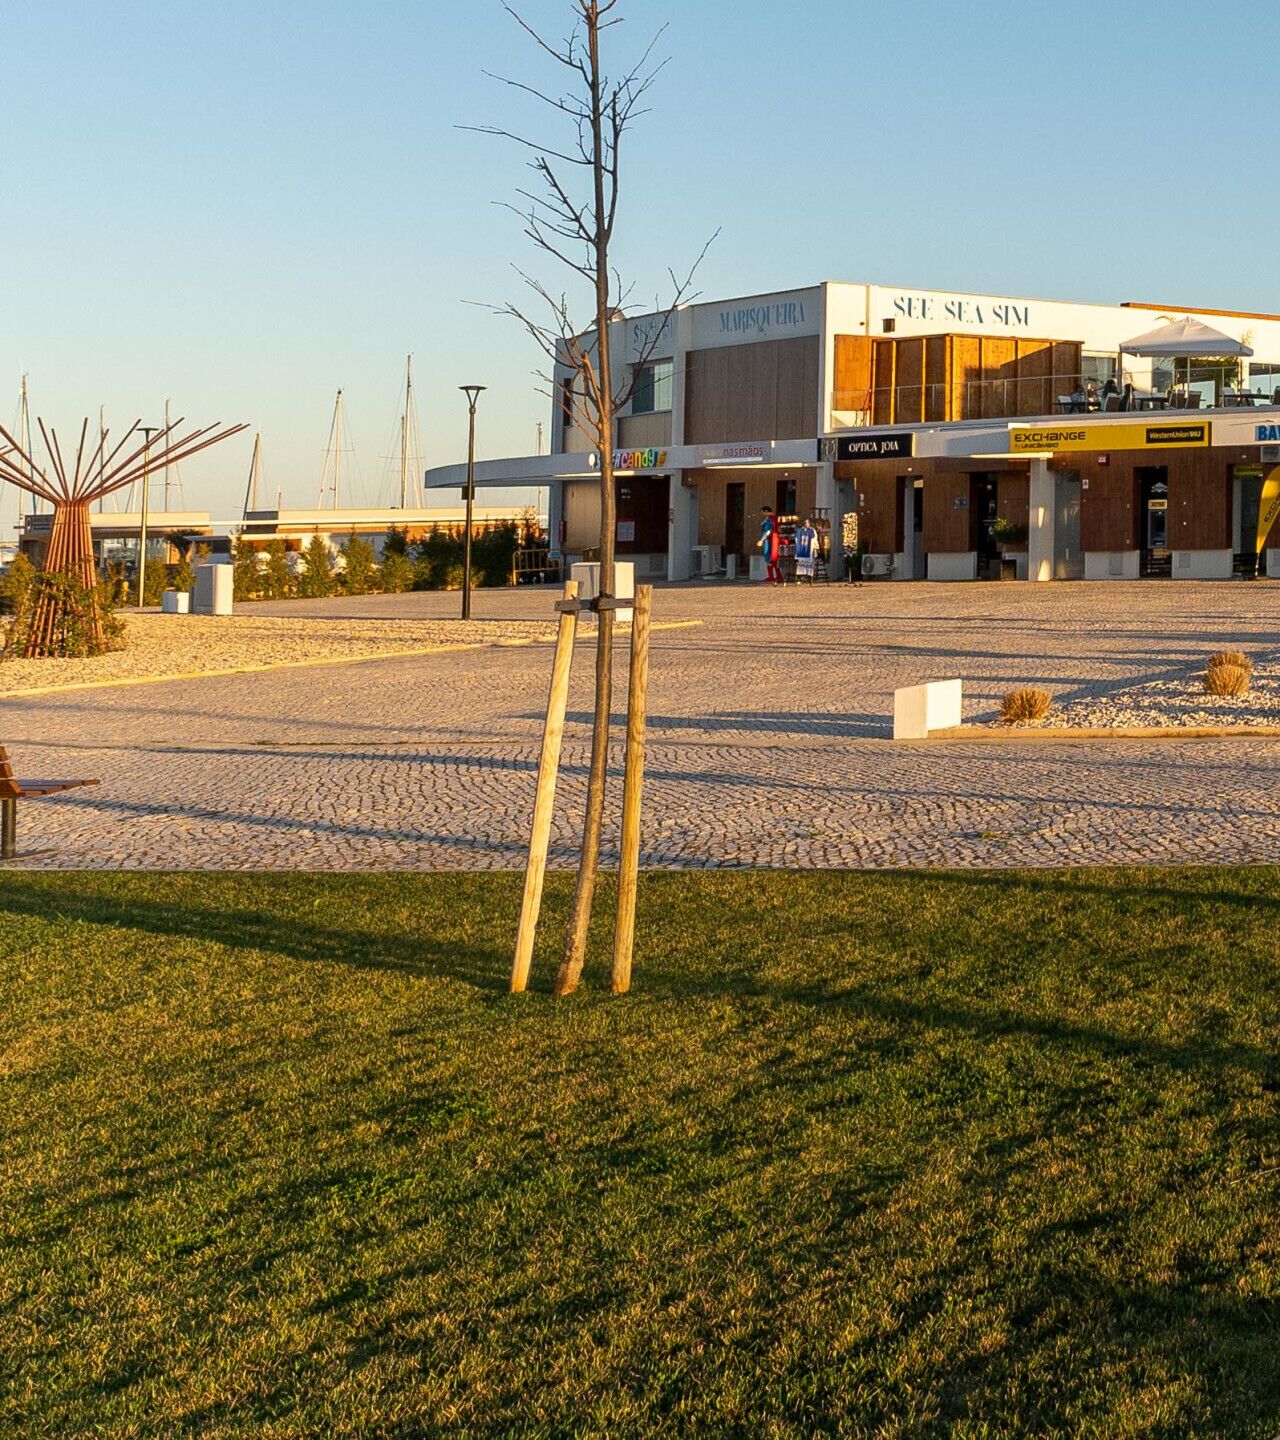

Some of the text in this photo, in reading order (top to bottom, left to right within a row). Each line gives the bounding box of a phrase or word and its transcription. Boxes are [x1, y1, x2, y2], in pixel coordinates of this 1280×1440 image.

[719, 302, 806, 334] MARISQUEIRA
[893, 296, 1029, 326] SEE SEA SIM
[880, 440, 899, 454] JOIA
